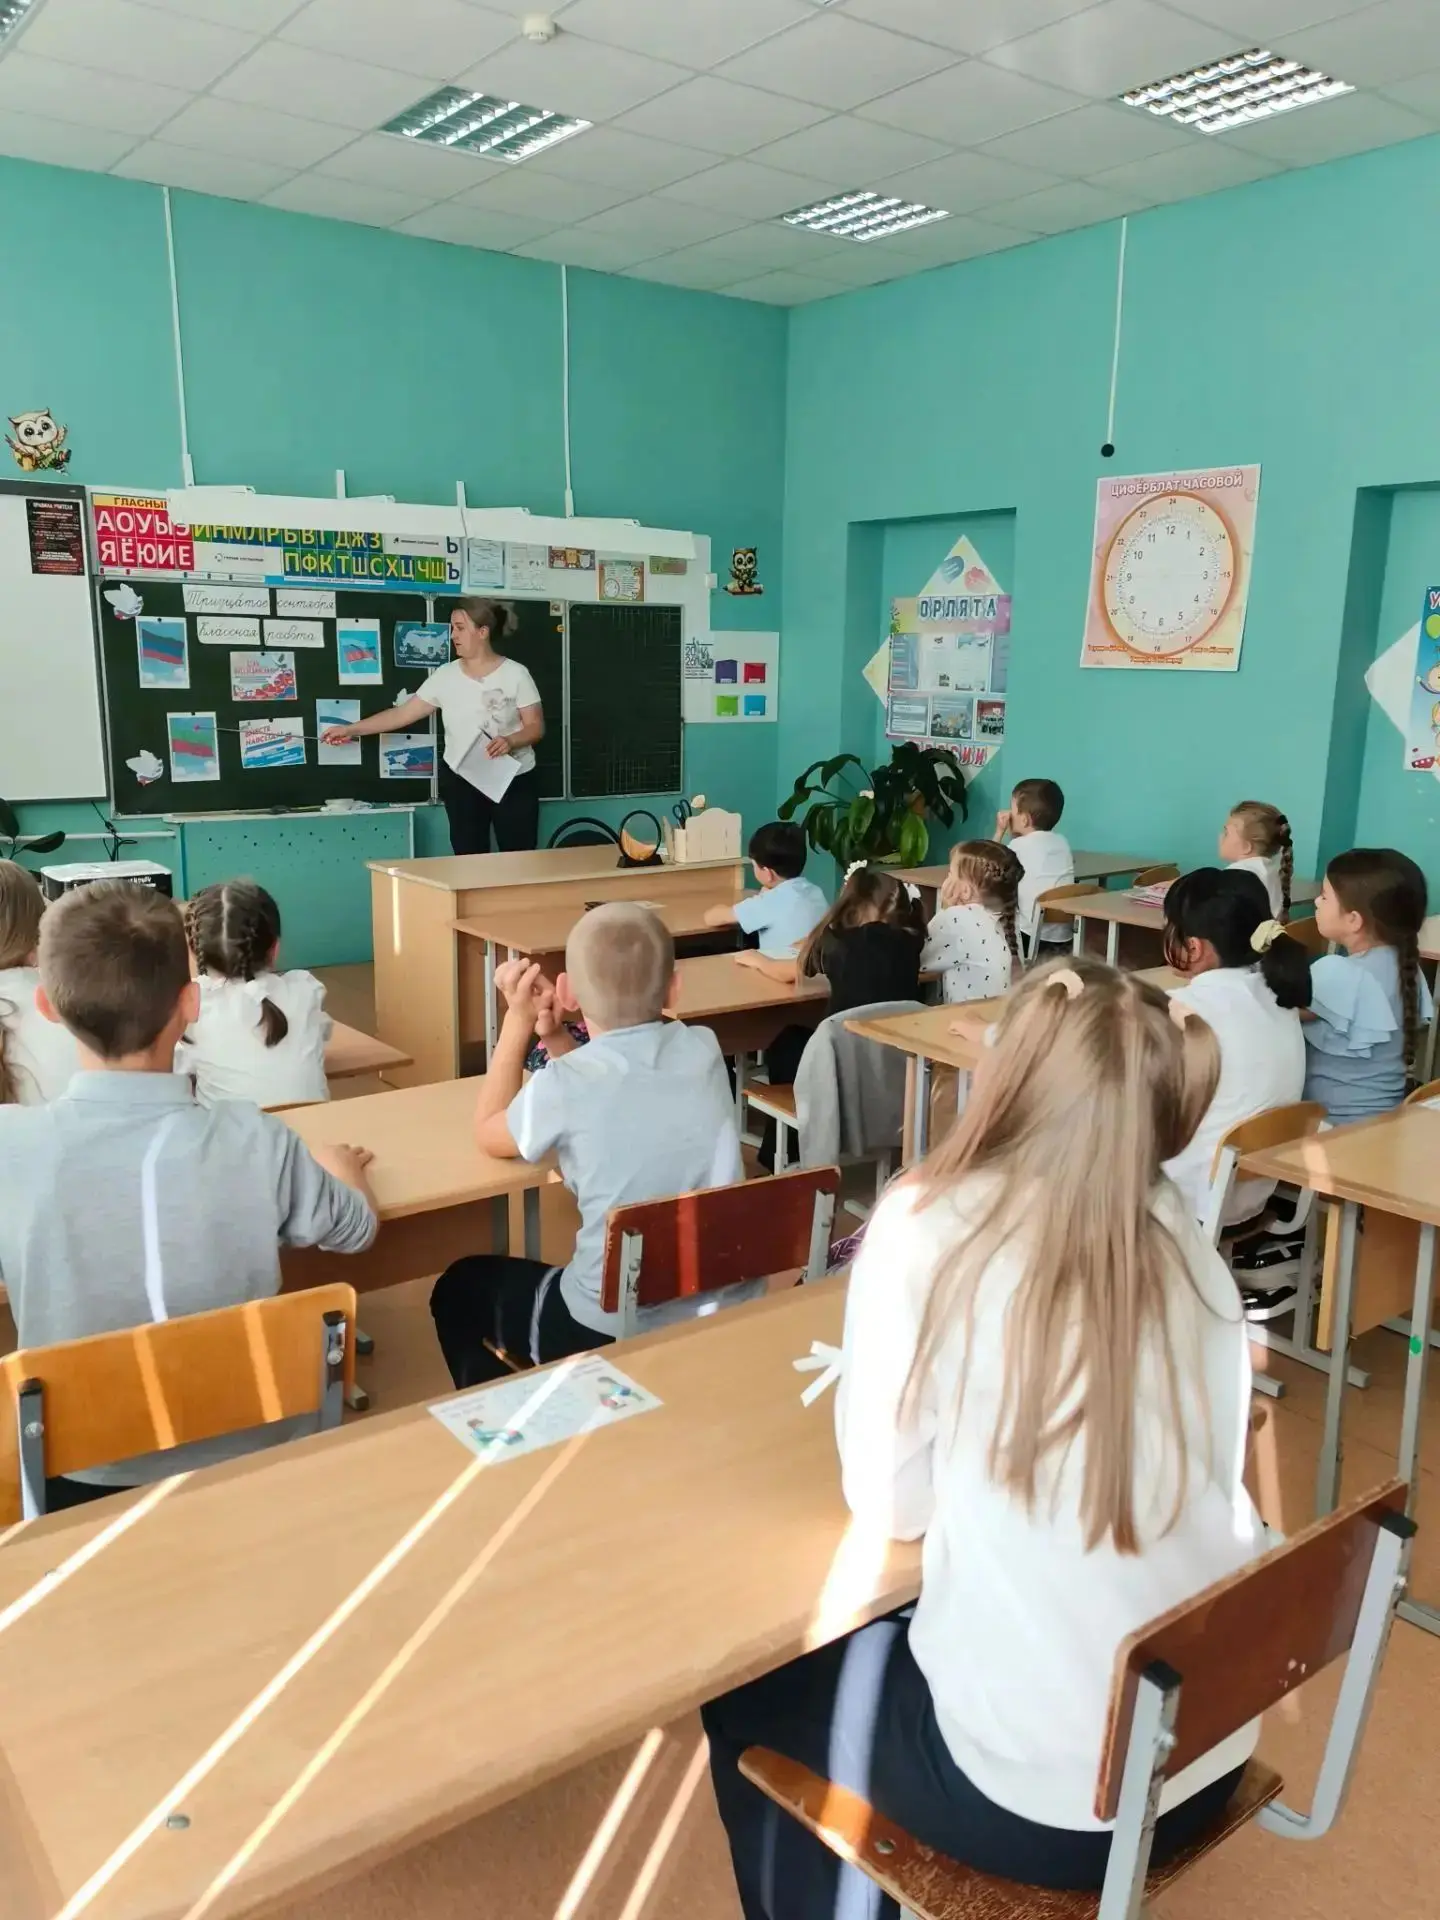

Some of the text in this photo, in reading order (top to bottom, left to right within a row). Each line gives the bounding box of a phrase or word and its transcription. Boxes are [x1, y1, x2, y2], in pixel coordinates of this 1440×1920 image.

[1111, 471, 1243, 498] ЦИФЕРБЛАТ ЧАСОВОЙ
[113, 497, 167, 509] ГЛАСНЫ
[1166, 526, 1176, 535] 12
[1148, 533, 1156, 543] 11
[1133, 551, 1143, 560] 10
[1199, 547, 1205, 556] 2
[1126, 573, 1132, 581] 9
[1203, 571, 1208, 580] 3
[1194, 594, 1199, 603] 4
[920, 598, 996, 617] ОРЛЯТА
[1141, 611, 1147, 619] 7
[1178, 611, 1183, 620] 5
[1158, 617, 1164, 626] 6
